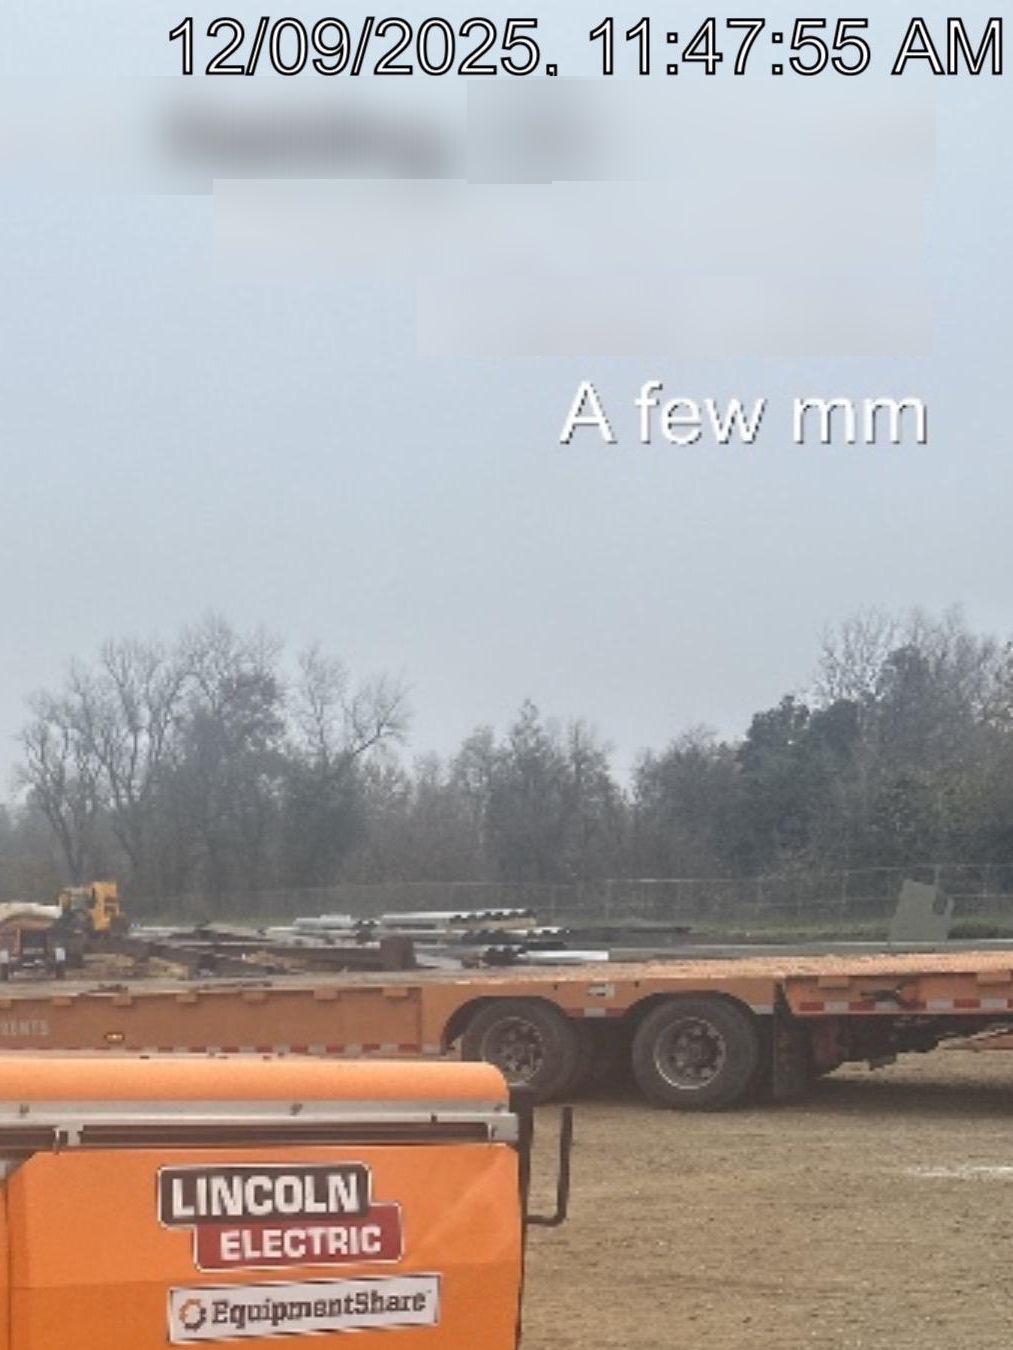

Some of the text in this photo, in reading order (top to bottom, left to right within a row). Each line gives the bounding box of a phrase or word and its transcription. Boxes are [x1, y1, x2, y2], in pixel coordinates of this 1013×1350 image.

[172, 1172, 361, 1218] LINCOLN
[220, 1225, 382, 1261] ELECTRIC
[211, 1290, 428, 1329] EquipmentShare
